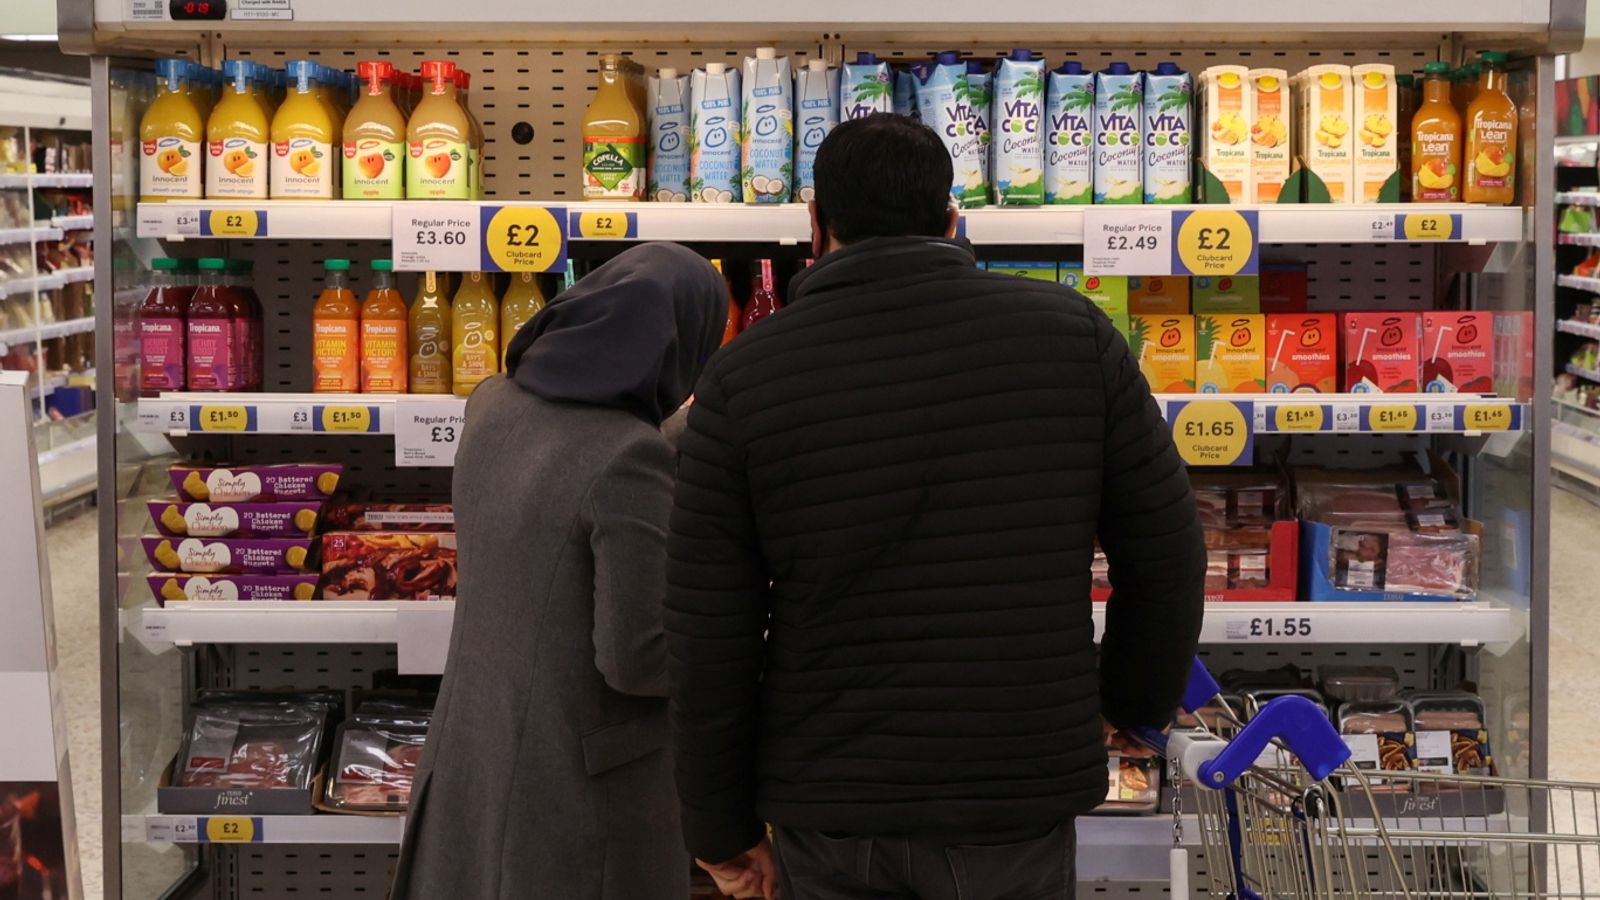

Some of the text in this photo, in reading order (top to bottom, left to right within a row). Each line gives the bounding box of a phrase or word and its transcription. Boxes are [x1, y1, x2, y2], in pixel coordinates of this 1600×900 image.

[1004, 99, 1040, 118] VITA
[1051, 112, 1088, 131] VITA
[1099, 112, 1136, 131] VITA
[1148, 112, 1186, 131] VITA
[1475, 117, 1513, 131] Tropicana
[1049, 132, 1092, 147] COCO
[1097, 132, 1141, 147] COCO
[1147, 132, 1190, 147] COCO
[1416, 131, 1454, 142] Tropicana
[1480, 130, 1507, 142] Lean
[1216, 148, 1245, 157] Tropicana
[1422, 142, 1449, 152] Lean
[749, 149, 784, 158] COCONUT
[1050, 146, 1088, 167] Coconut
[1099, 146, 1137, 167] Coconut
[1148, 146, 1187, 167] Coconut
[1255, 151, 1284, 160] Tropicana
[1317, 149, 1347, 158] Tropicana
[1361, 148, 1391, 158] Tropicana
[592, 153, 625, 166] COPELLA
[699, 160, 734, 170] COCONUT
[755, 160, 778, 169] WATER
[152, 175, 189, 184] innocent
[218, 176, 254, 185] innocent
[285, 176, 321, 184] innocent
[659, 174, 681, 183] WATER
[704, 171, 728, 180] WATER
[226, 215, 243, 227] £2
[411, 218, 471, 229] Regular Price
[596, 217, 613, 229] £2
[1420, 219, 1437, 231] £2
[506, 223, 540, 247] £2
[1102, 224, 1162, 235] Regular Price
[416, 231, 467, 245] £3.60
[1107, 236, 1158, 250] £2.49
[1197, 228, 1231, 250] £2
[506, 250, 542, 259] Clubcard
[1197, 254, 1232, 262] Clubcard
[1204, 262, 1224, 270] Price
[141, 322, 173, 333] Tropicana
[189, 322, 221, 333] Tropicana
[315, 323, 347, 334] Tropicana
[364, 323, 397, 334] Tropicana
[316, 340, 347, 348] VITAMIN
[365, 340, 397, 348] VITAMIN
[316, 348, 347, 357] VICTORY
[365, 348, 397, 357] VICTORY
[1222, 353, 1260, 361] smoothies
[1291, 353, 1330, 361] smoothies
[1371, 353, 1412, 361] smoothies
[170, 411, 185, 422] £3
[210, 411, 239, 422] £1.50
[293, 411, 308, 423] £3
[332, 411, 362, 423] £1.50
[414, 415, 447, 427] Regular
[1286, 411, 1315, 422] £1.65
[1379, 411, 1408, 422] £1.65
[1474, 410, 1503, 422] £1.65
[1185, 421, 1235, 437] £1.65
[431, 427, 455, 443] £3
[1192, 444, 1229, 452] Clubcard
[1200, 451, 1220, 460] Price
[217, 477, 247, 490] Simply
[278, 476, 315, 484] Battered
[273, 489, 306, 497] Nuggets
[195, 512, 224, 525] Simply
[243, 511, 292, 520] 20 Battered
[334, 538, 344, 548] 25
[188, 548, 216, 560] Simply
[235, 547, 283, 556] 20 Battered
[243, 560, 275, 568] Nuggets
[195, 585, 224, 597] Simply
[242, 584, 290, 593] 20 Battered
[1250, 617, 1312, 637] £1.55
[213, 792, 249, 809] finest
[223, 822, 239, 834] £2
